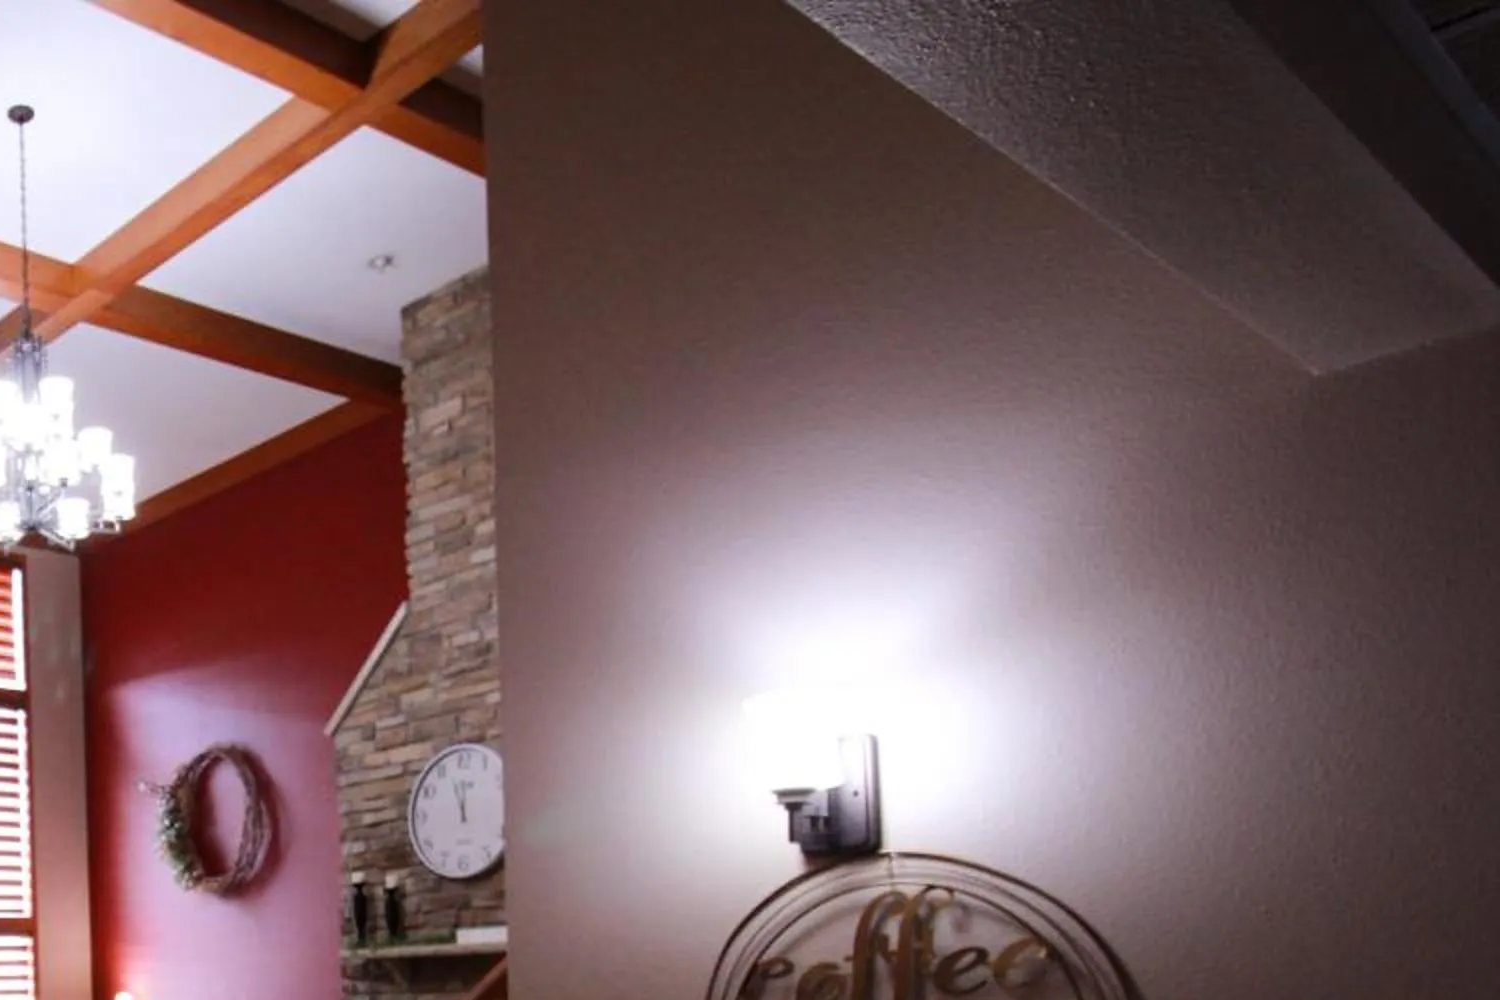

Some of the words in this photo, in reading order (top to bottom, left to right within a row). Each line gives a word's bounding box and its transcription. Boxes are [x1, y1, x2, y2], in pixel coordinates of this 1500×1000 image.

[457, 751, 472, 770] 12
[422, 783, 437, 800] 10
[457, 854, 470, 871] 6
